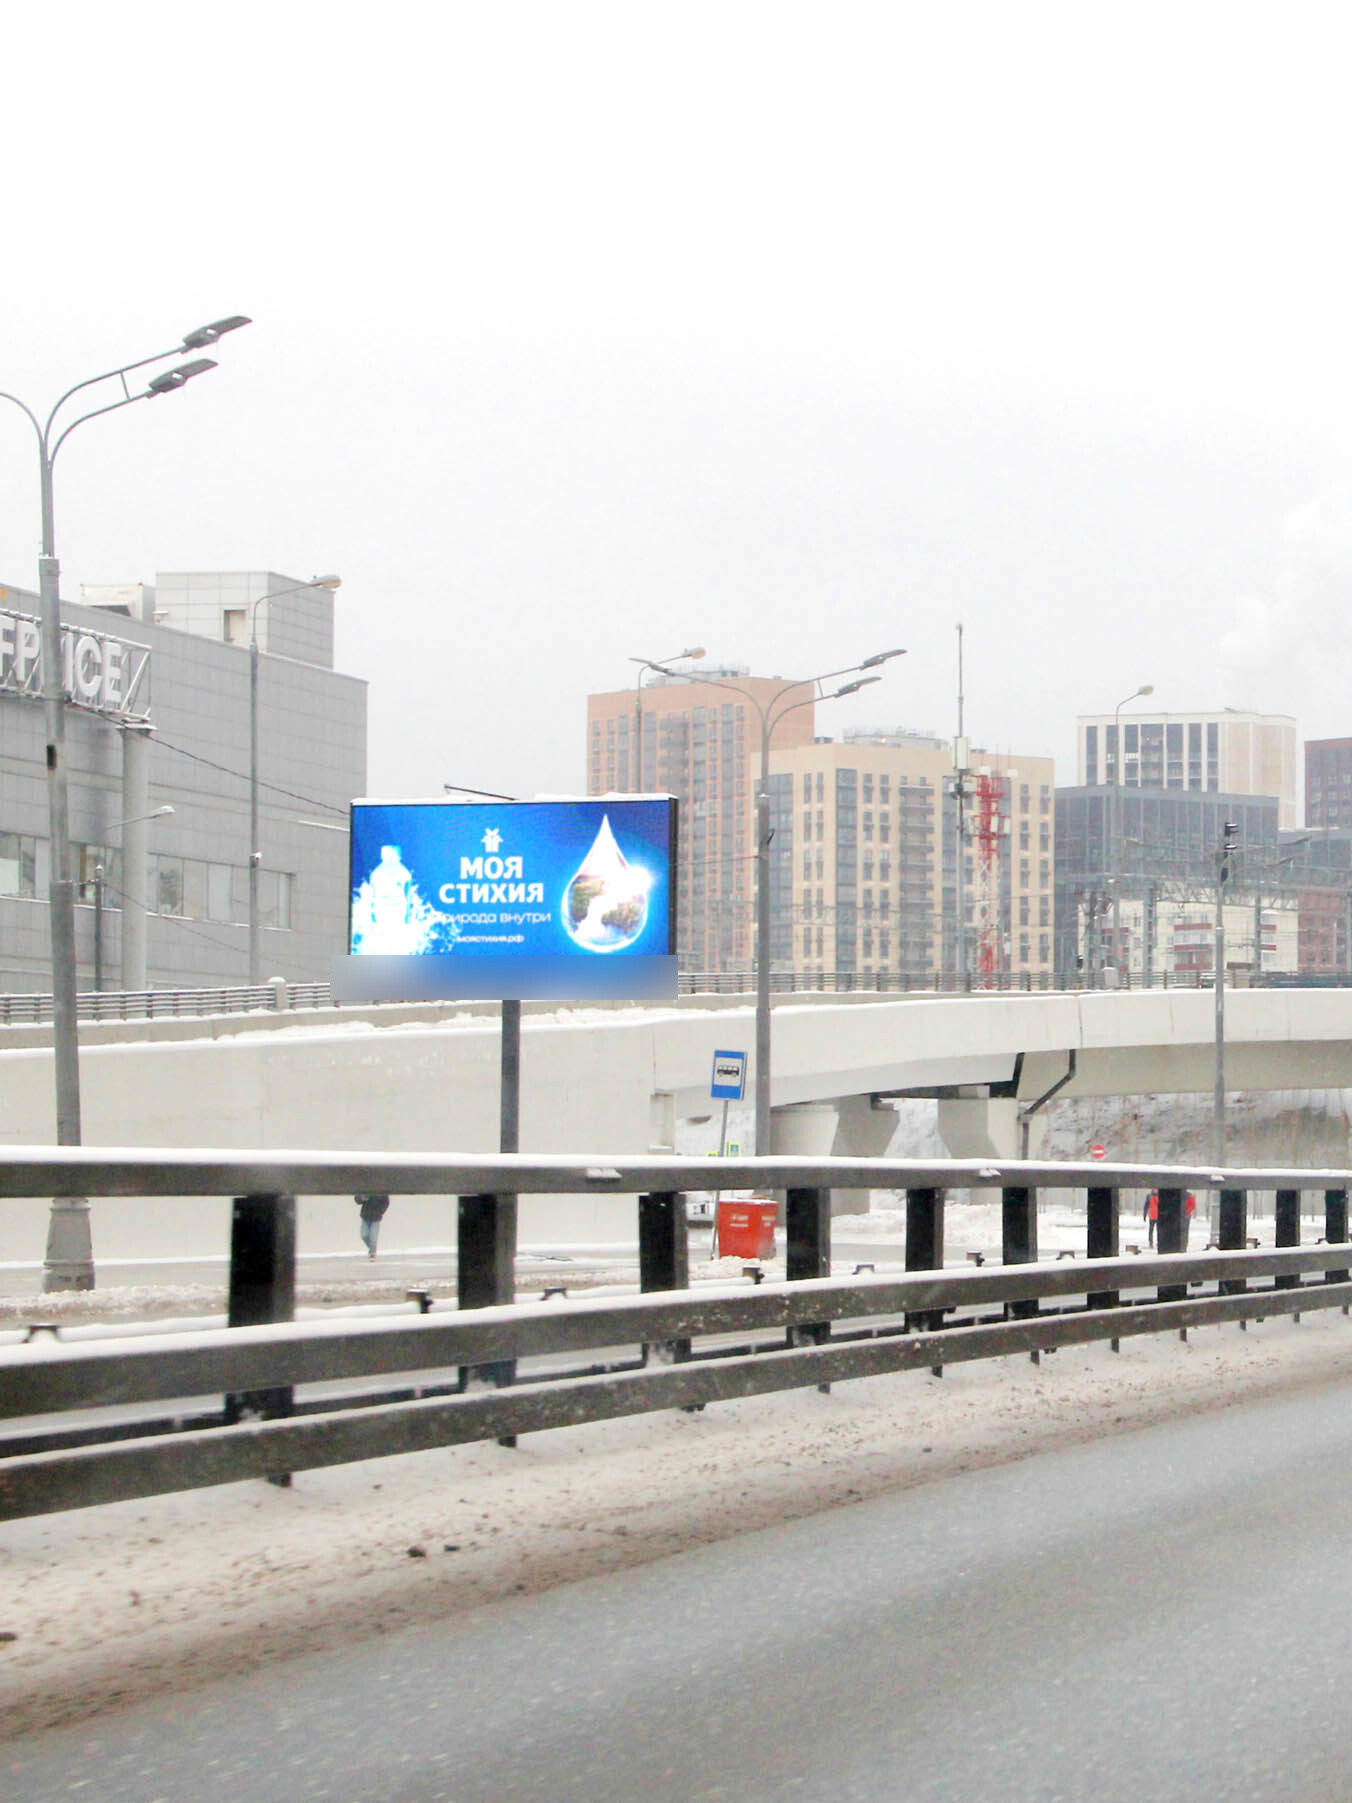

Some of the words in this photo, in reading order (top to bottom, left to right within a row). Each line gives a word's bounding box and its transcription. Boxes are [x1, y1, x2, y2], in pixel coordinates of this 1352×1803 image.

[460, 856, 523, 879] МОЯ
[439, 882, 544, 904] СТИХИЯ
[500, 912, 551, 925] внутри
